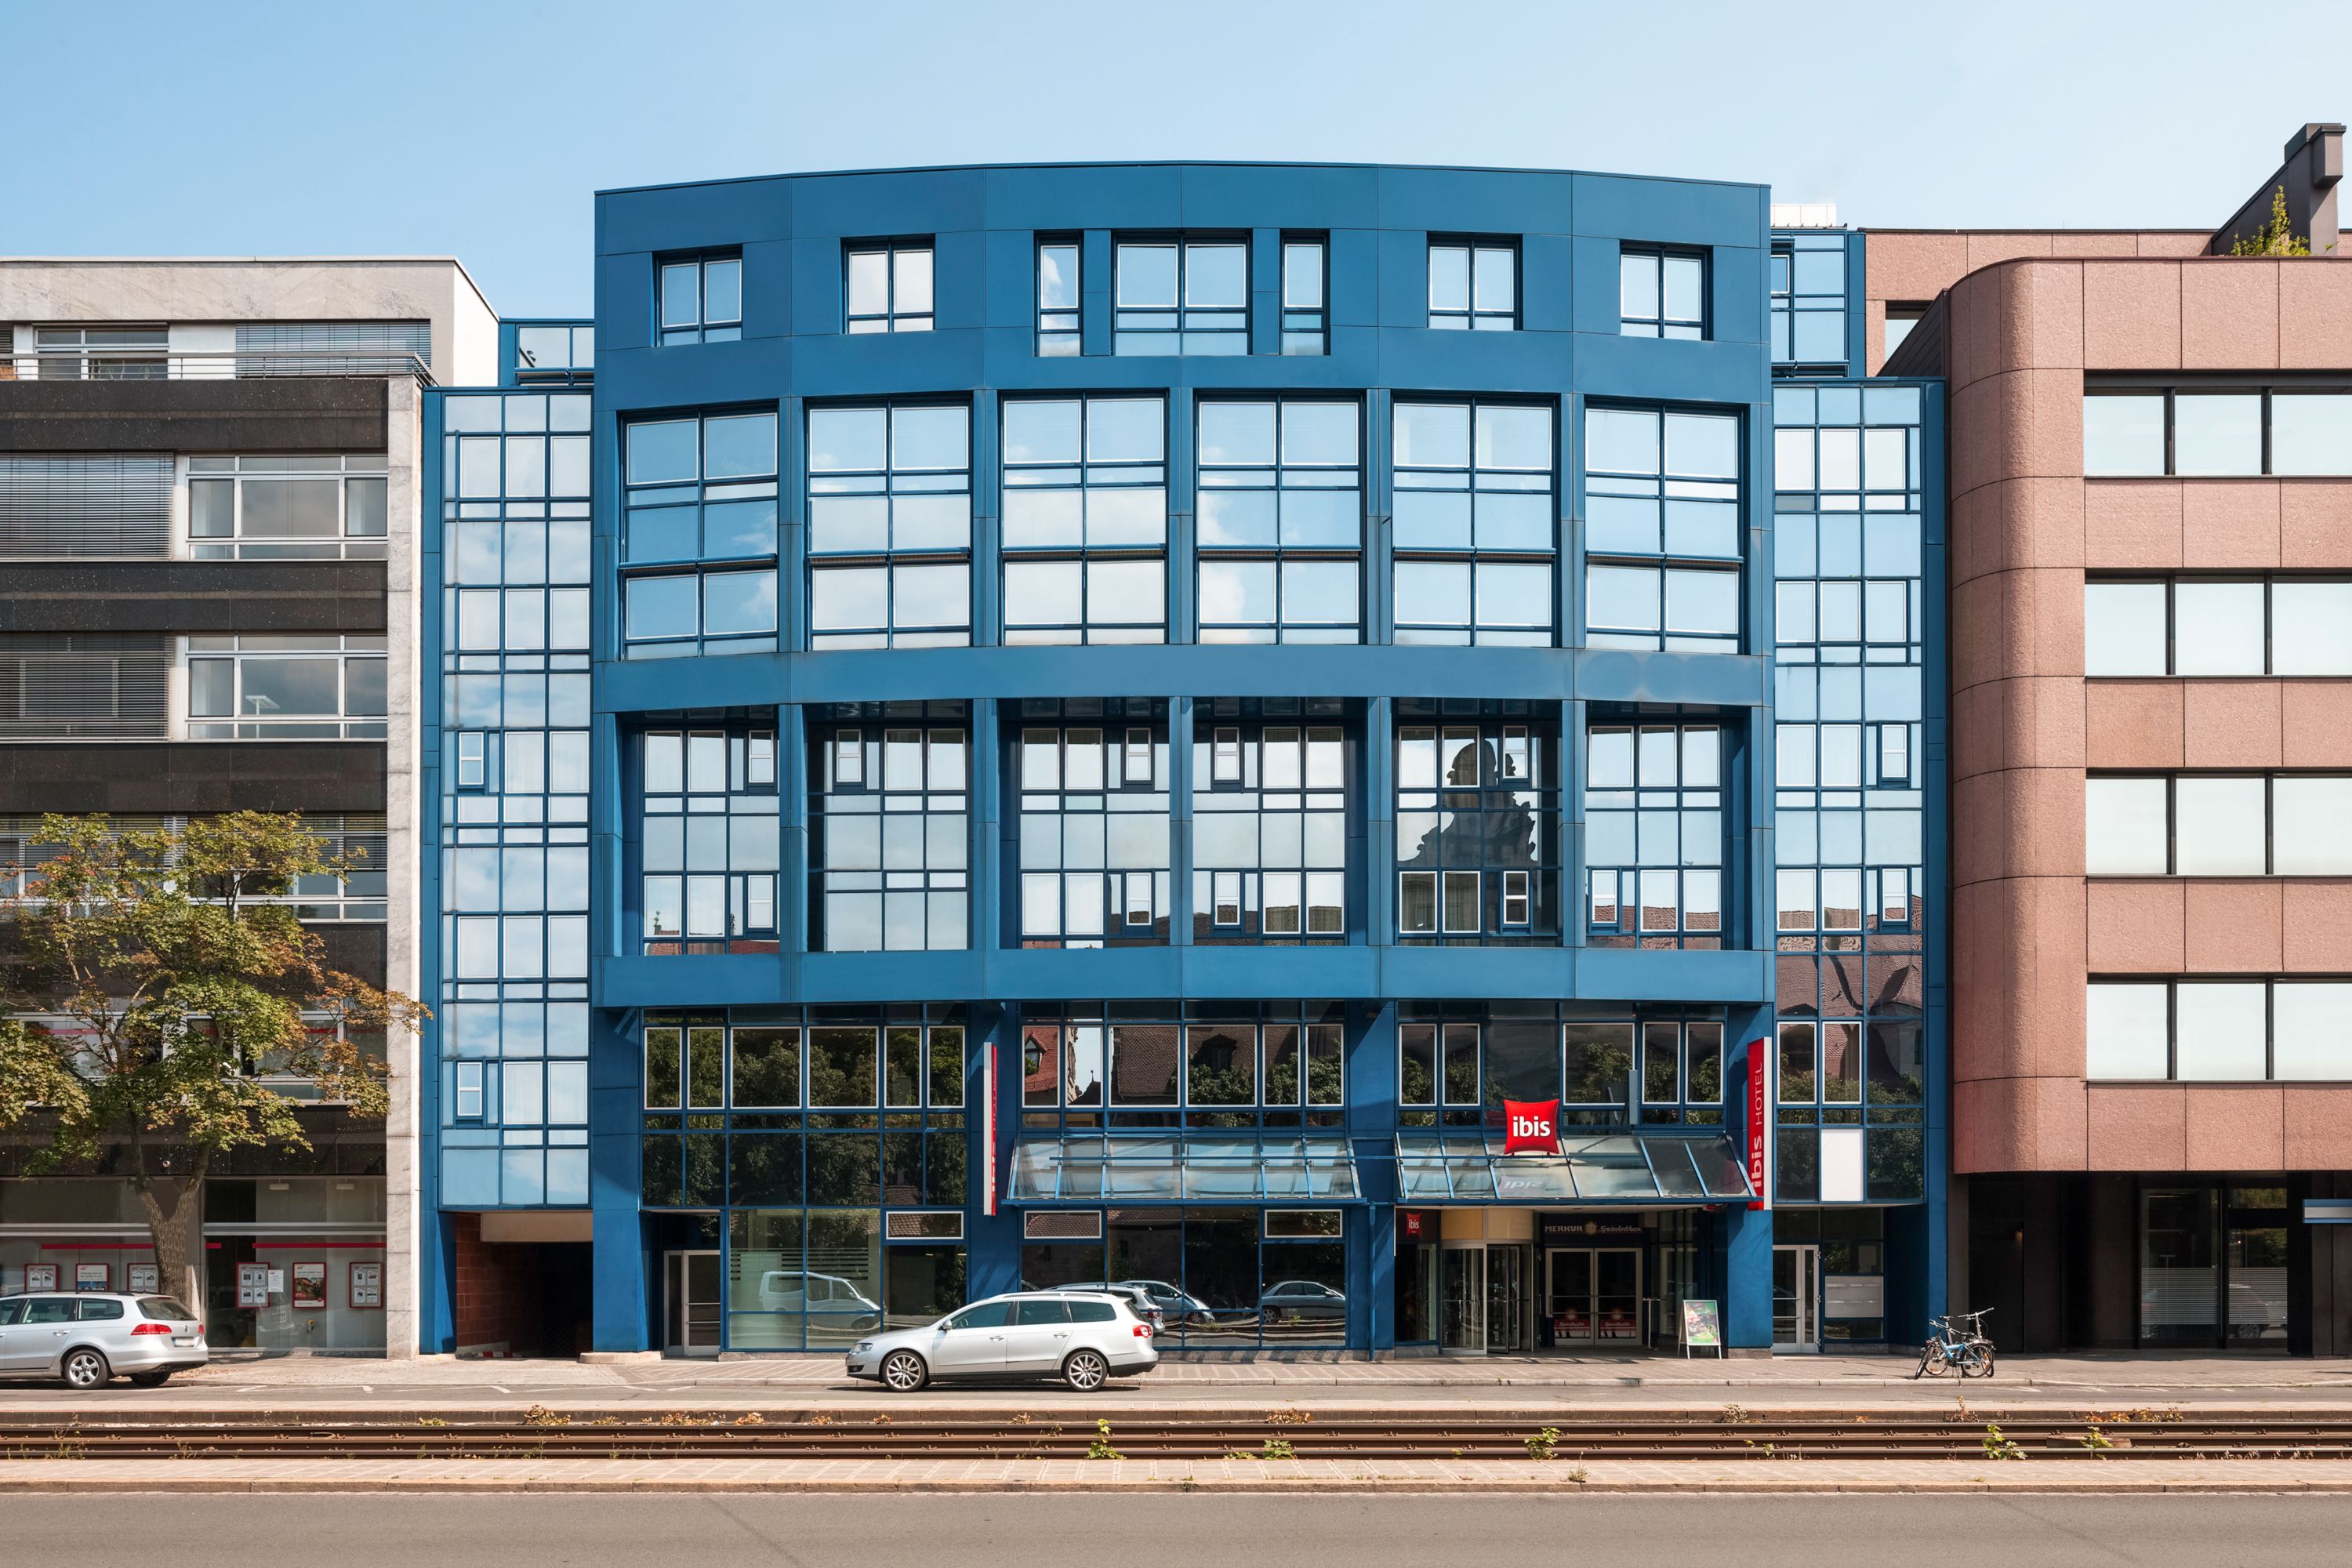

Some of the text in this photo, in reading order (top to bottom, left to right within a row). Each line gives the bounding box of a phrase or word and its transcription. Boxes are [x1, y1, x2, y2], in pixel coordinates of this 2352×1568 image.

[1512, 1116, 1551, 1137] ibis
[1751, 1134, 1762, 1188] ibis
[1408, 1219, 1420, 1229] ibis
